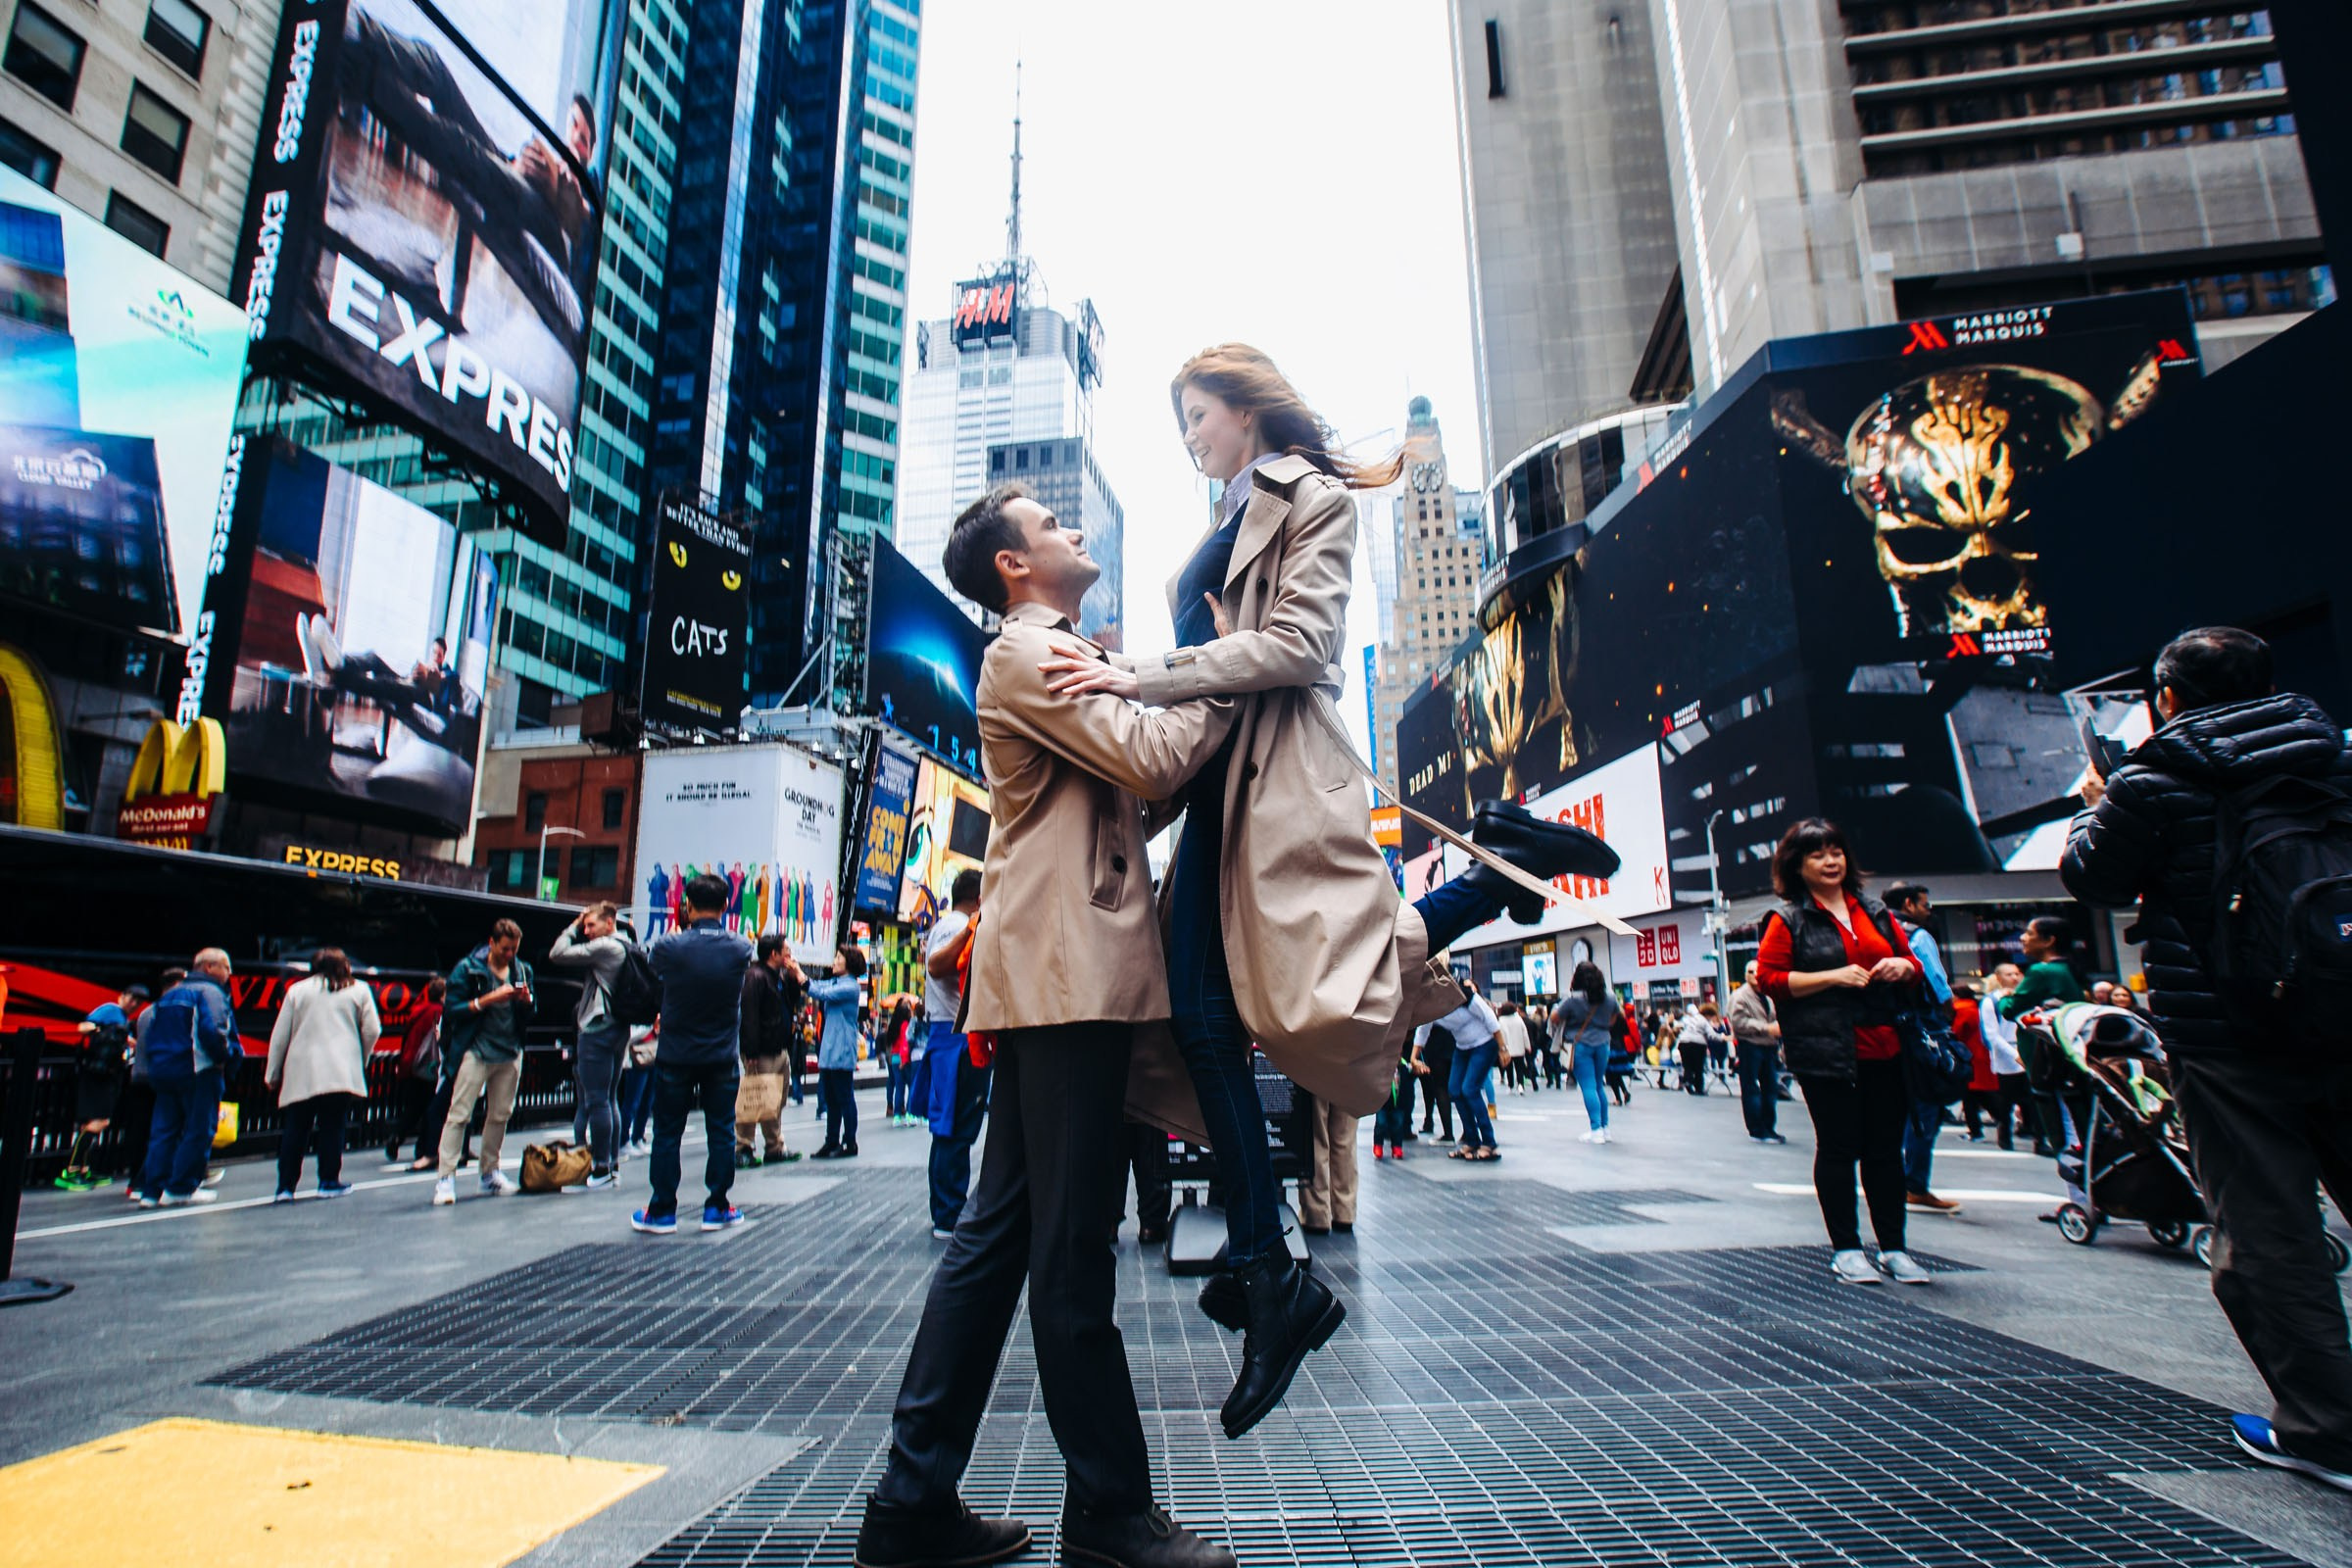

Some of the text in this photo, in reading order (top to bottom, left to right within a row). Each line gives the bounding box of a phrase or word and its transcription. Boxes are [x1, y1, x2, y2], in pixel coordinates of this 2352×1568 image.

[273, 20, 320, 165] EXPRESS
[246, 189, 290, 342] EXPRESS
[955, 283, 1014, 329] H&M
[1953, 305, 2053, 331] MARRIOTT
[1954, 320, 2045, 345] MARQUIS
[1653, 417, 1693, 465] MARRIOTT
[670, 614, 729, 659] CATS
[1982, 627, 2051, 644] MARRIOTT
[1983, 638, 2047, 655] MARQUIS
[176, 610, 217, 733] EXPRE
[1408, 763, 1434, 798] DEAD
[119, 804, 206, 823] McDonald's
[802, 808, 816, 824] DAY
[285, 844, 401, 881] EXPRESS
[1660, 930, 1677, 946] UNI
[1661, 945, 1679, 964] QLO
